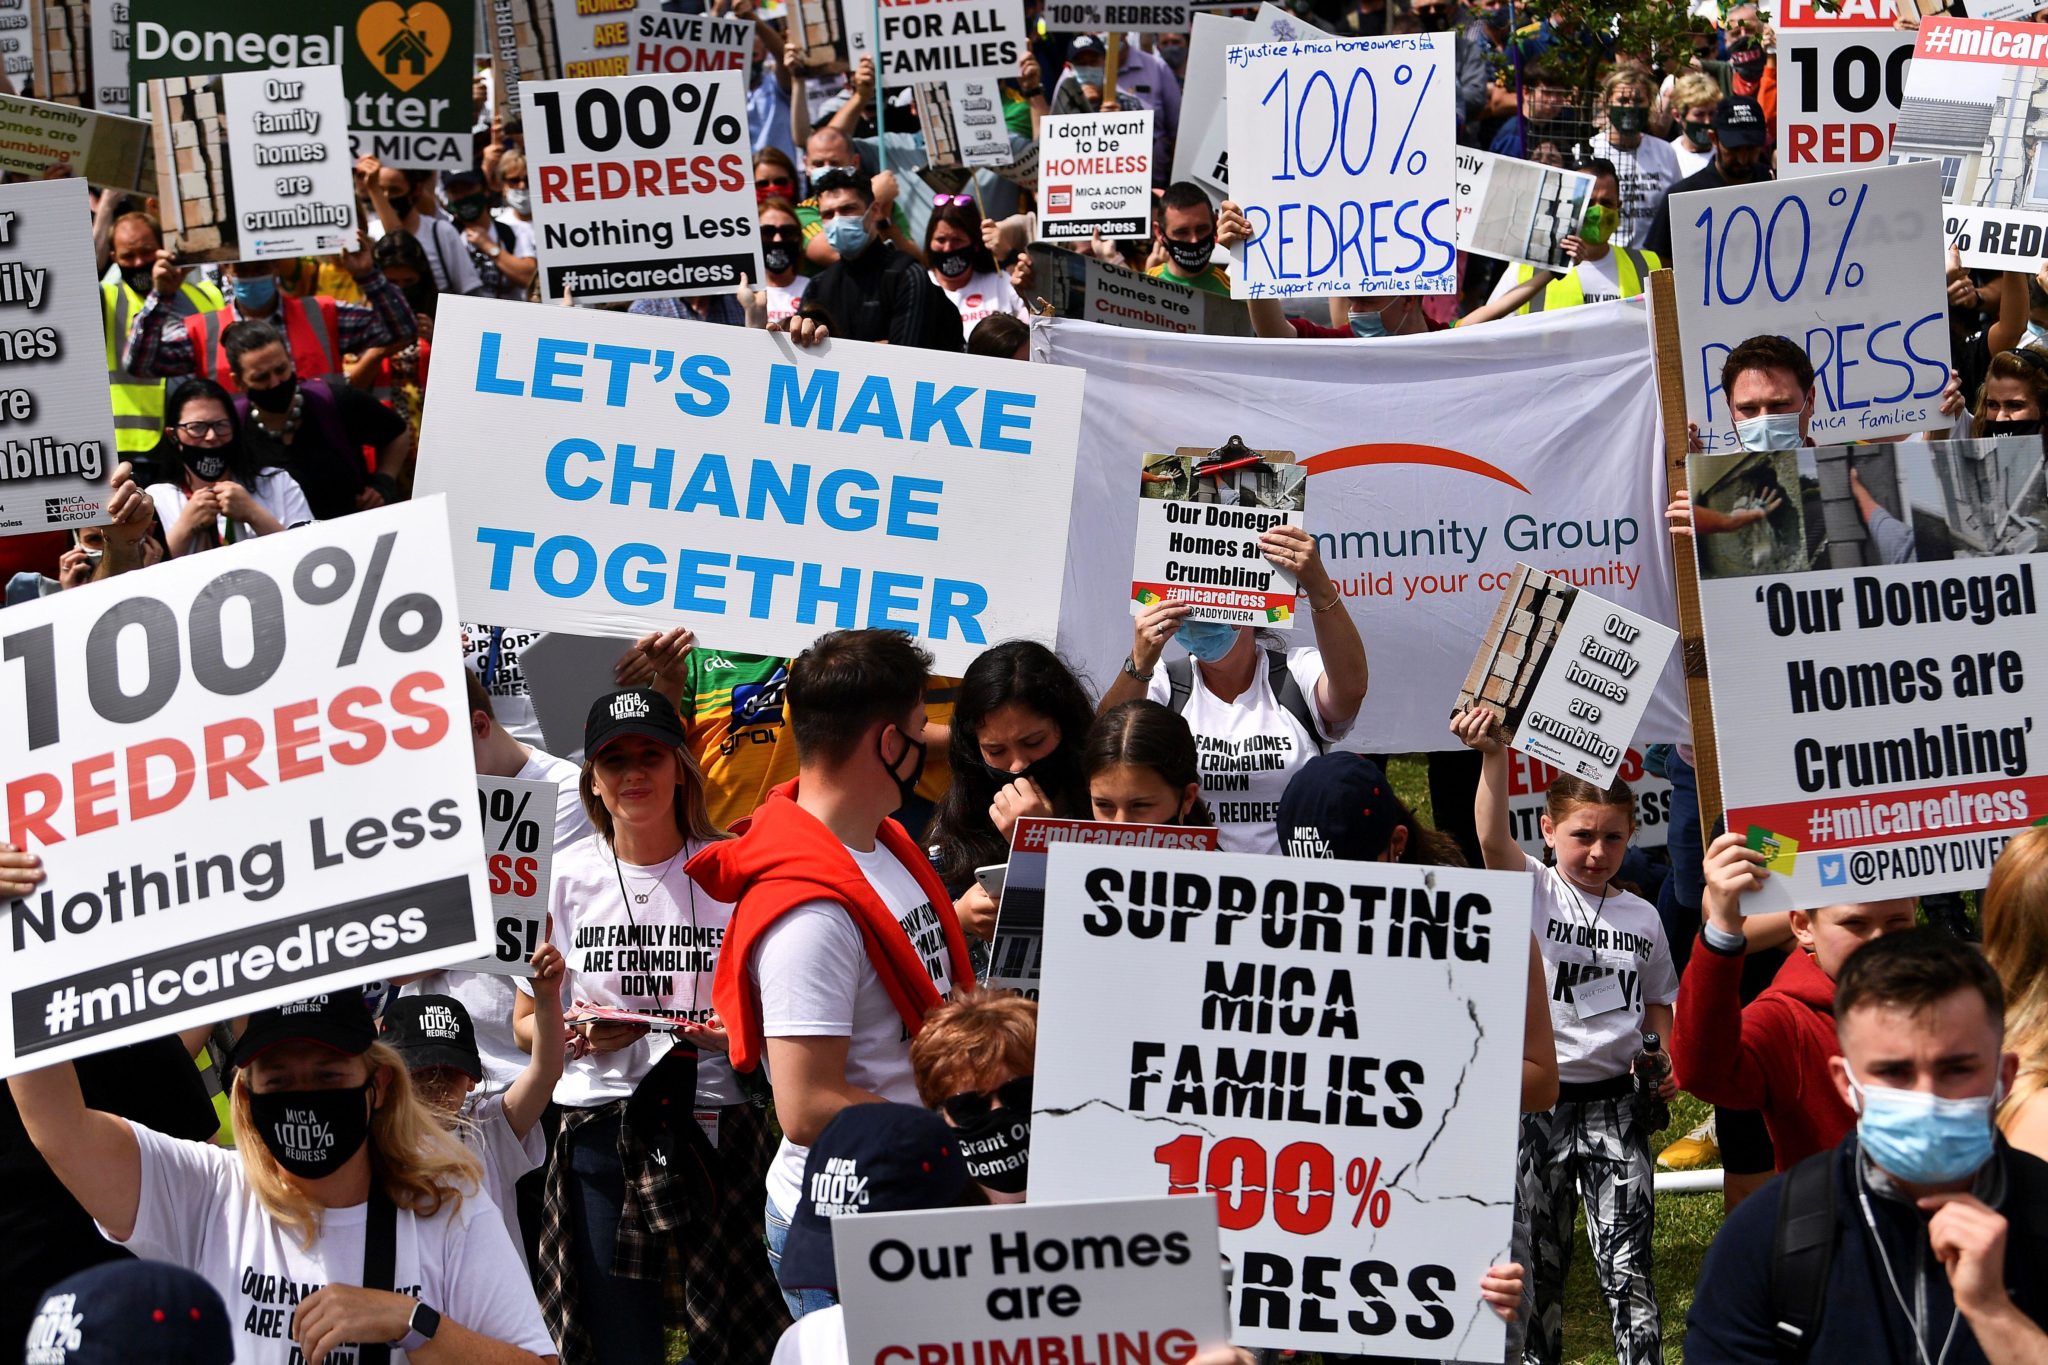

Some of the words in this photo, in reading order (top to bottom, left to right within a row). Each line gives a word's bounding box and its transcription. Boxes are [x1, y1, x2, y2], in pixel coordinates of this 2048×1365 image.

[884, 14, 942, 40] FOR
[952, 9, 1006, 35] ALL
[1048, 5, 1099, 24] 100%
[1105, 6, 1185, 25] REDRESS
[137, 21, 344, 70] Donegal
[594, 22, 628, 47] ARE
[640, 16, 703, 43] SAVE
[711, 23, 749, 46] MY
[636, 44, 746, 73] HOME
[879, 41, 1018, 75] FAMILIES
[1228, 46, 1288, 68] #justice
[1304, 41, 1332, 54] mica
[1335, 38, 1417, 52] homeowners
[266, 80, 302, 101] Our
[30, 105, 88, 127] Family
[254, 109, 320, 136] family
[533, 83, 742, 155] 100%
[1049, 124, 1053, 138] I
[1059, 121, 1097, 138] dont
[1103, 119, 1145, 135] want
[1262, 64, 1437, 181] 100%
[47, 129, 78, 143] are
[373, 136, 463, 161] MICA
[1076, 138, 1092, 153] to
[1098, 137, 1119, 152] be
[255, 142, 326, 166] homes
[1046, 155, 1148, 177] HOMELESS
[276, 175, 311, 197] are
[539, 153, 745, 204] REDRESS
[1076, 188, 1102, 197] MICA
[1104, 186, 1143, 196] ACTION
[244, 205, 349, 232] crumbling
[1091, 201, 1127, 211] GROUP
[544, 219, 673, 251] Nothing
[683, 214, 752, 241] Less
[1243, 198, 1456, 282] REDRESS
[1696, 184, 1868, 307] 100%
[0, 262, 47, 309] ily
[562, 262, 735, 291] #micaredress
[1317, 279, 1351, 292] mica
[1359, 277, 1410, 292] families
[1098, 278, 1157, 305] homes
[1160, 299, 1190, 316] are
[476, 332, 731, 418] LET'S
[764, 364, 1037, 454] MAKE
[1812, 416, 1846, 432] MICA
[1859, 409, 1927, 429] families
[61, 496, 85, 505] MICA
[545, 438, 944, 541] CHANGE
[62, 503, 99, 513] ACTION
[62, 511, 97, 521] GROUP
[1162, 503, 1202, 526] 'Our
[1206, 506, 1288, 532] Donegal
[1170, 532, 1239, 557] Homes
[1243, 541, 1262, 559] ar
[1313, 519, 1488, 563] mmunity
[1504, 514, 1639, 555] Group
[476, 527, 989, 645] TOGETHER
[1166, 561, 1275, 592] Crumbling'
[1404, 572, 1468, 602] your
[1478, 561, 1641, 593] comunity
[1167, 588, 1266, 608] #micaredress
[1755, 582, 1844, 637] 'Our
[1853, 563, 2037, 629] Donegal
[3, 531, 443, 752] 100%
[1603, 613, 1639, 643] Our
[1580, 635, 1640, 678] family
[1566, 661, 1628, 702] homes
[1787, 657, 1943, 714] Homes
[1951, 650, 2024, 698] are
[609, 700, 650, 716] 100%
[616, 693, 640, 702] MICA
[1570, 697, 1601, 722] are
[616, 711, 645, 720] REDRESS
[1196, 734, 1241, 757] FAMILY
[1244, 735, 1292, 752] HOMES
[1527, 711, 1620, 767] crumbling
[6, 671, 451, 853] REDRESS
[1201, 753, 1285, 772] CRUMBLING
[1794, 717, 2033, 792] Crumbling'
[1204, 774, 1249, 791] DOWN
[1219, 802, 1280, 823] REDRES
[1808, 789, 2029, 843] #micaredress
[1024, 823, 1209, 851] #micaredress
[1294, 826, 1320, 840] MICA
[1288, 839, 1334, 859] 100%
[1850, 835, 2012, 886] @PADDYDIVE
[11, 840, 285, 952] Nothing
[309, 799, 462, 870] Less
[1083, 868, 1492, 963] SUPPORTING
[575, 927, 605, 949] OUR
[608, 925, 666, 947] FAMILY
[670, 926, 725, 948] HOMES
[1547, 918, 1574, 945] FIX
[1576, 926, 1609, 949] OUR
[1613, 931, 1653, 962] HOMES
[45, 907, 428, 1036] #micaredress
[583, 951, 614, 972] ARE
[618, 951, 713, 972] CRUMBLING
[622, 976, 673, 996] DOWN
[1201, 961, 1359, 1039] MICA
[282, 1004, 322, 1016] REDRESS
[419, 1014, 460, 1033] 100%
[425, 1005, 452, 1016] MICA
[426, 1029, 456, 1040] REDRESS
[1128, 1041, 1425, 1129] FAMILIES
[286, 1108, 317, 1125] MICA
[274, 1122, 335, 1150] 100%
[958, 1132, 1008, 1157] Grant
[286, 1147, 327, 1162] REDRESS
[825, 1157, 857, 1176] MICA
[967, 1148, 1029, 1177] Deman
[810, 1173, 869, 1205] 100%
[1154, 1134, 1392, 1236] 100%
[869, 1239, 973, 1282] Our
[990, 1230, 1191, 1277] Homes
[242, 1266, 276, 1304] OUR
[1222, 1251, 1457, 1340] RESS
[986, 1284, 1082, 1321] are
[245, 1305, 285, 1338] ARE
[874, 1328, 1198, 1365] CRUMBLING
